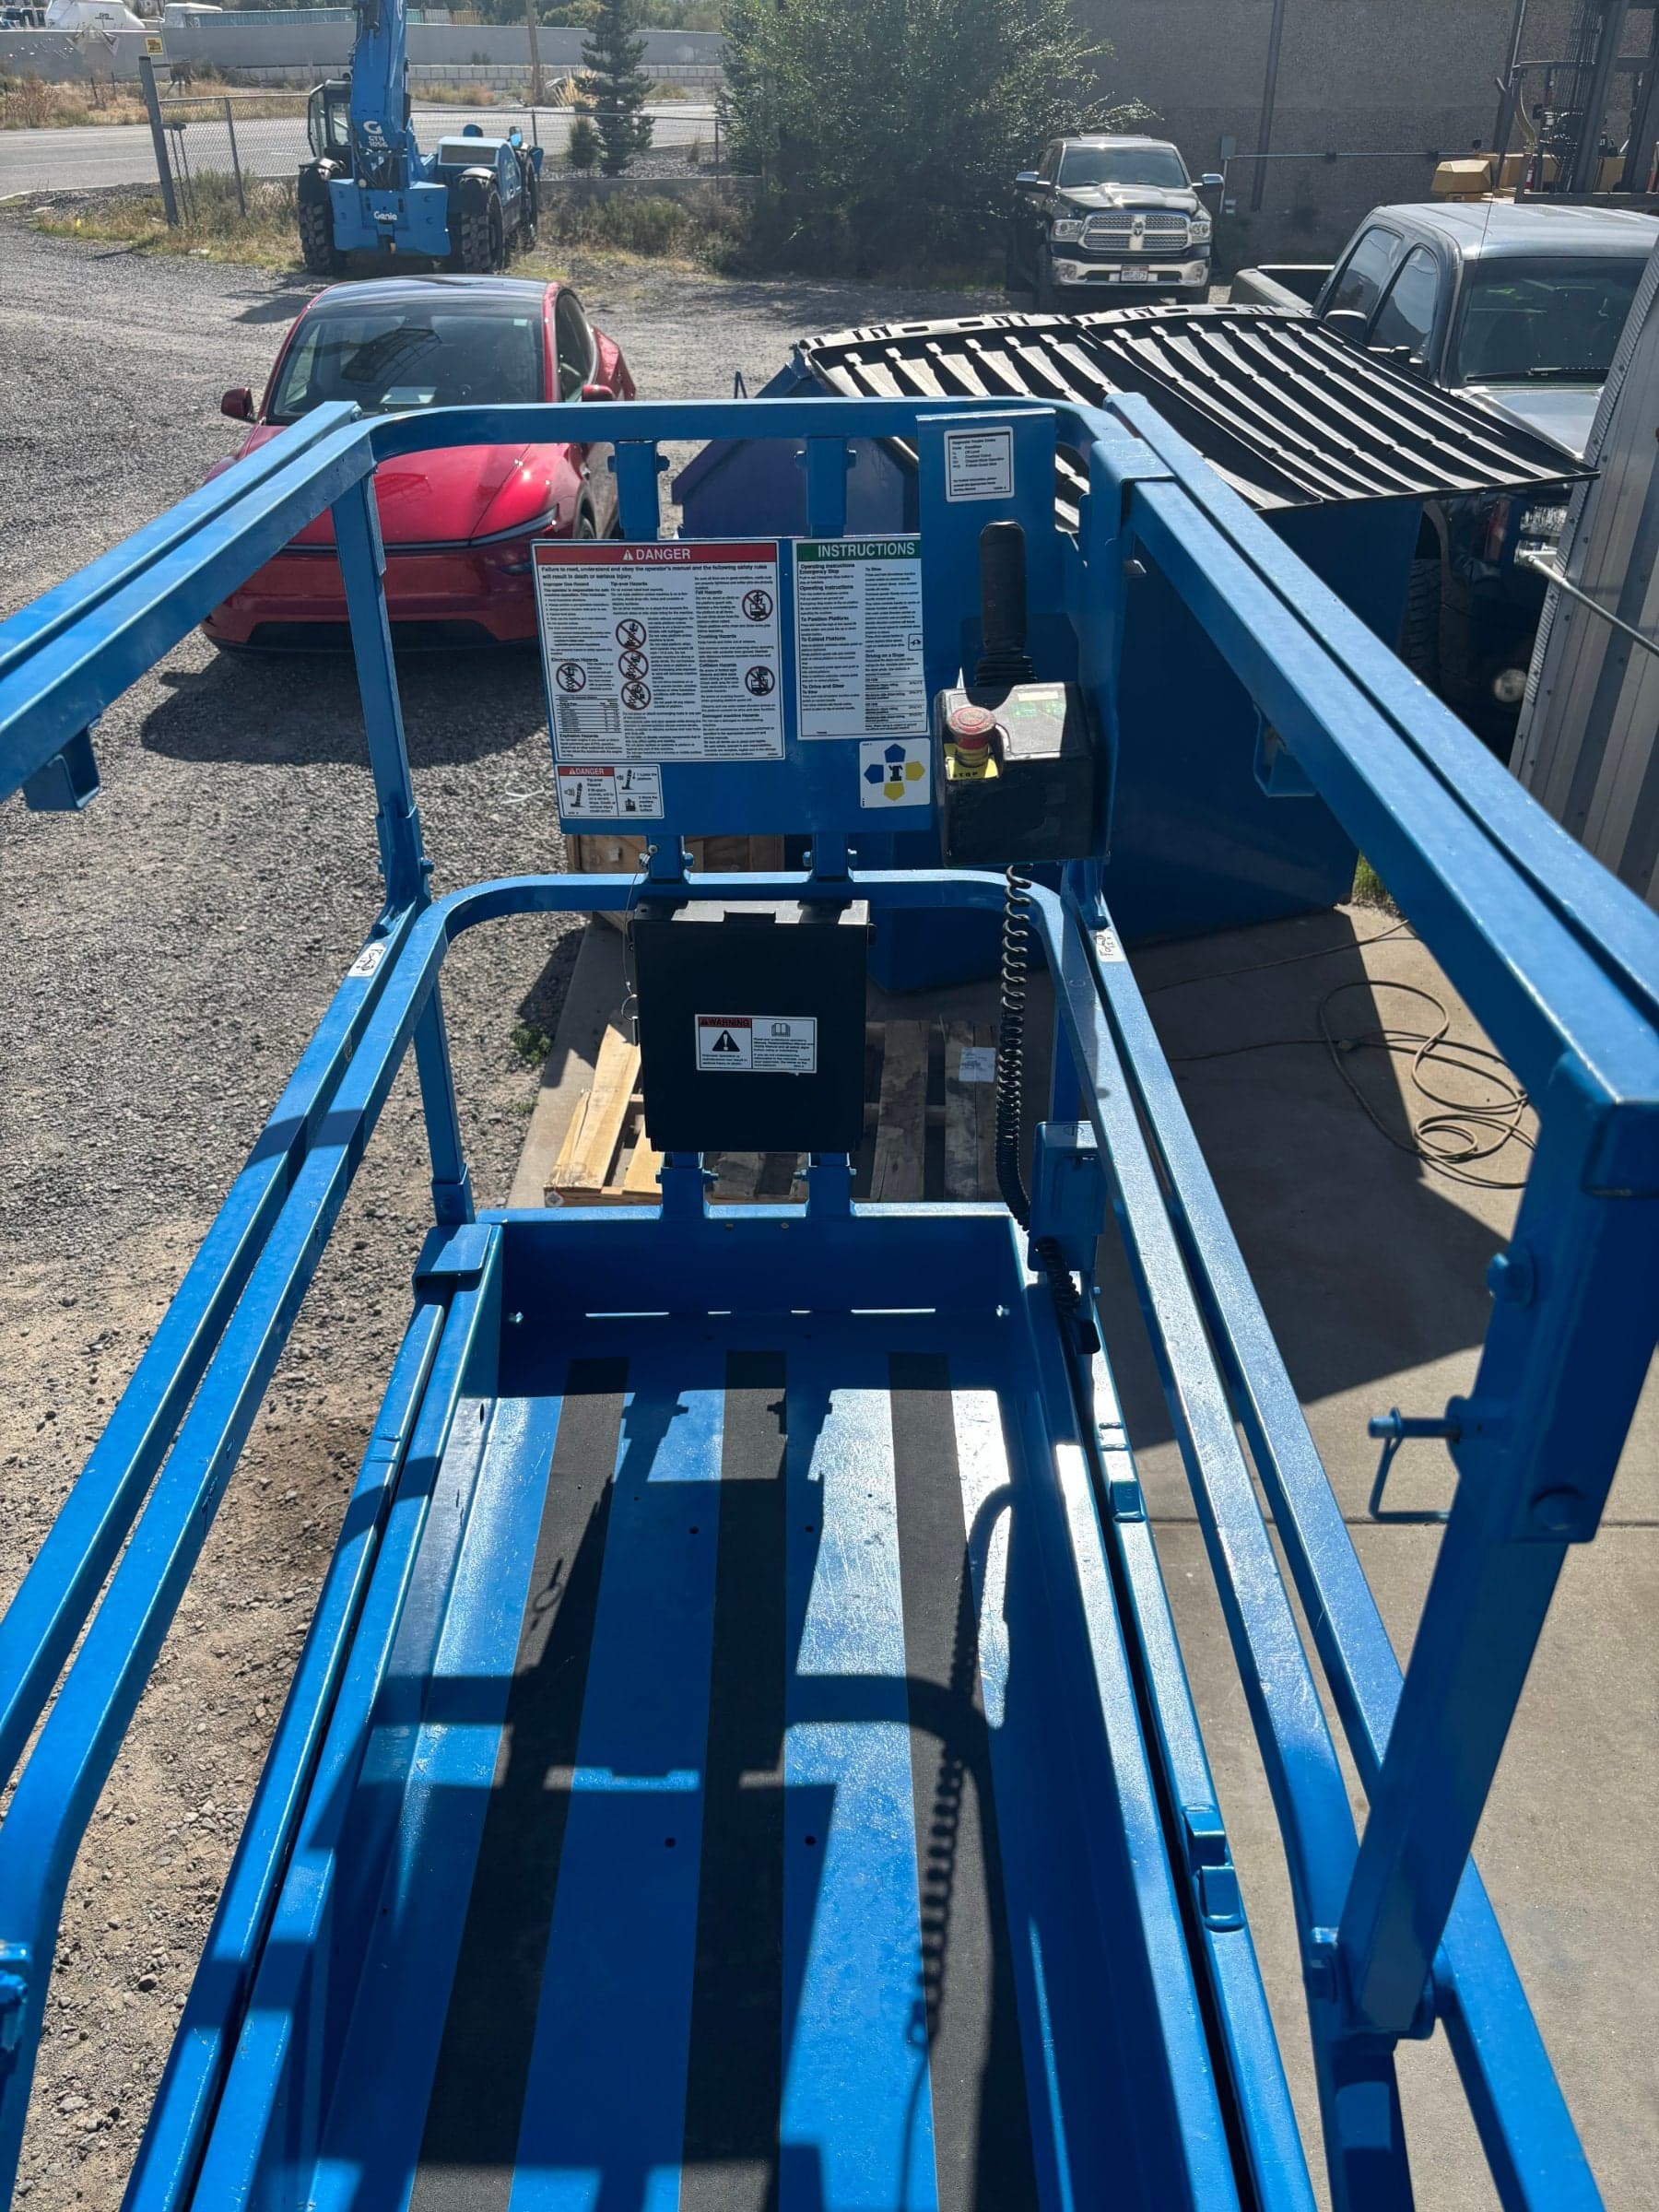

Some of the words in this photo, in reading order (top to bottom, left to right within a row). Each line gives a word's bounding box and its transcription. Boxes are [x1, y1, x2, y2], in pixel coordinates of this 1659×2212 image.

[373, 211, 397, 221] Genie
[636, 548, 691, 560] DANGER
[818, 542, 915, 558] INSTRUCTIONS
[709, 1018, 749, 1027] WARNING
